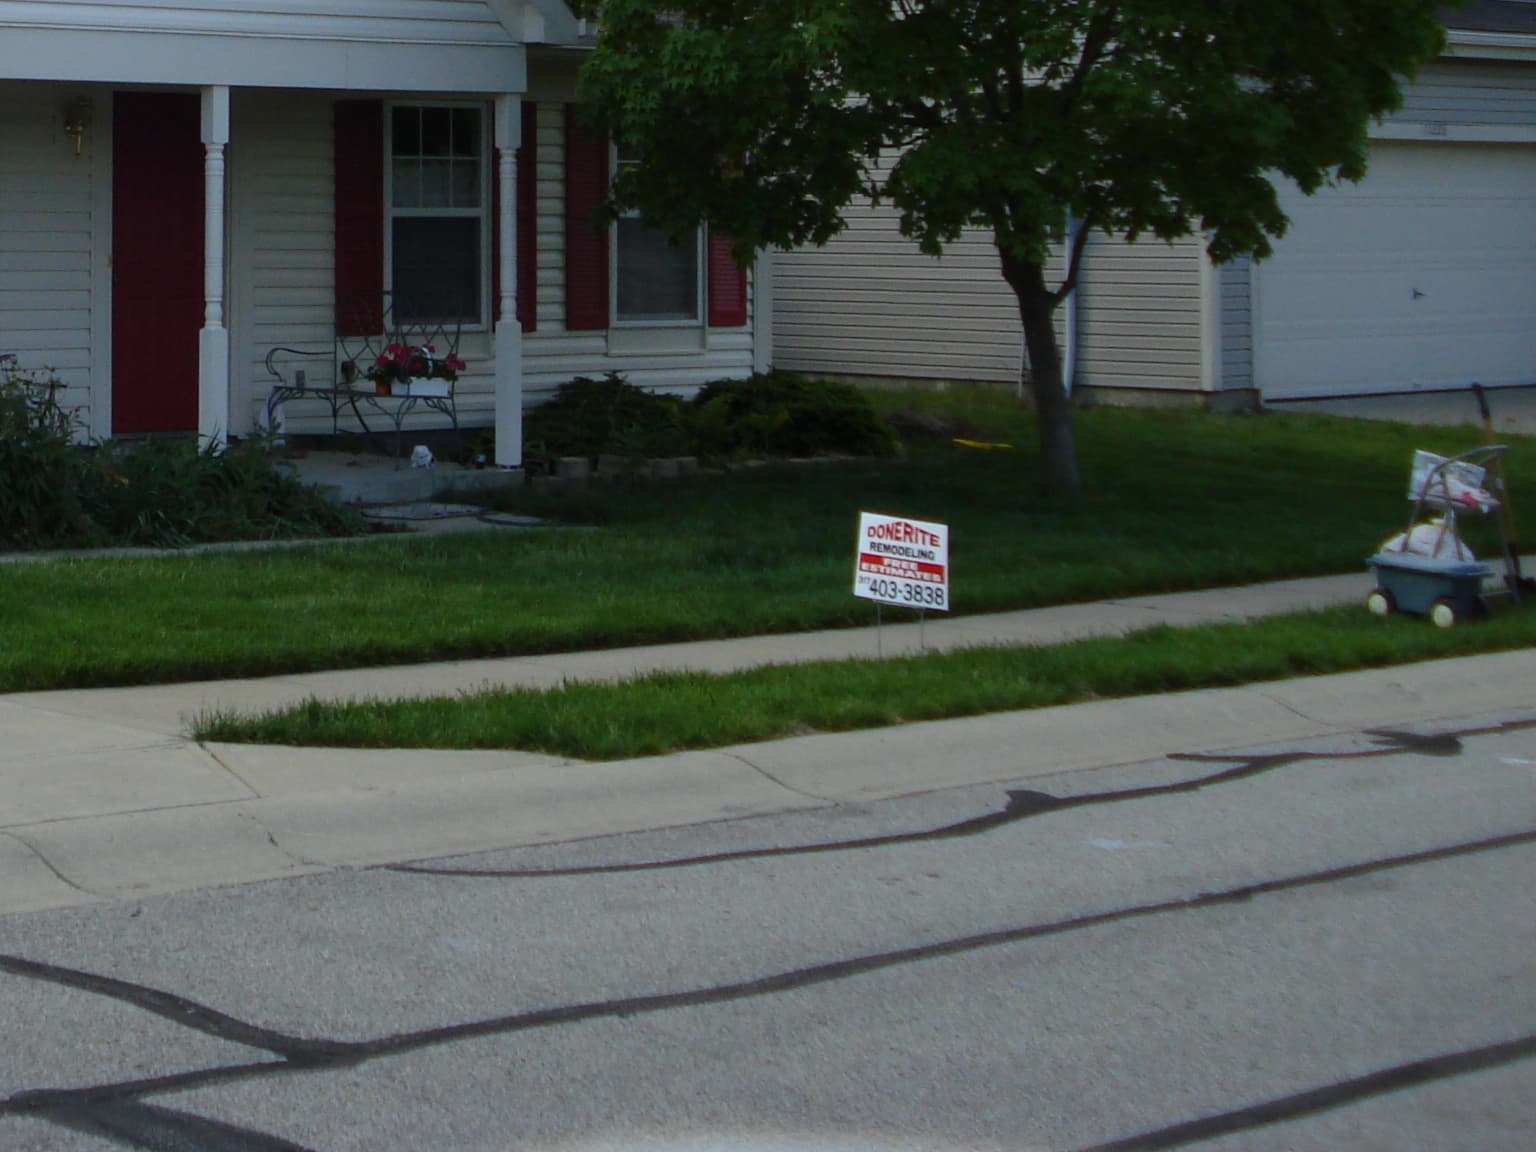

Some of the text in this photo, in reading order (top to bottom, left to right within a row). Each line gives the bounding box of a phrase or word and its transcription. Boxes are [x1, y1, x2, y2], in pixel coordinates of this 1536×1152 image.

[867, 521, 941, 547] DONERITE
[869, 541, 935, 561] REMODELING
[861, 562, 942, 581] ESTIMATES
[883, 557, 918, 570] FREE
[869, 578, 944, 606] 403-3838
